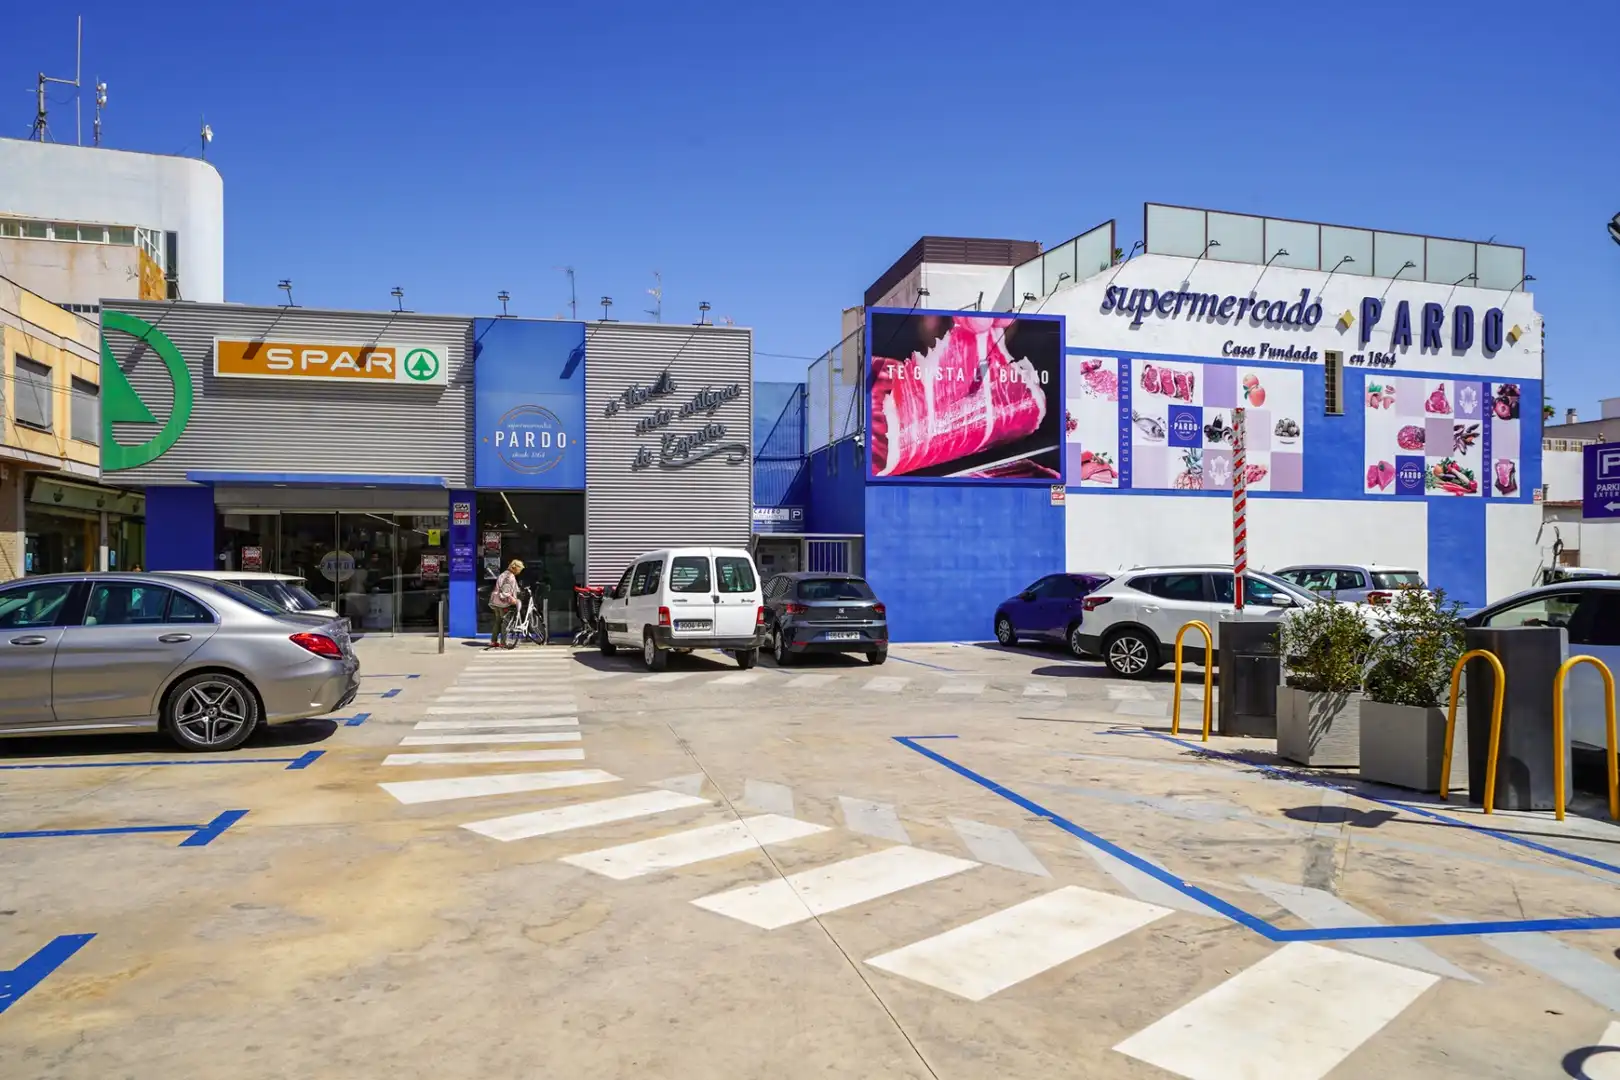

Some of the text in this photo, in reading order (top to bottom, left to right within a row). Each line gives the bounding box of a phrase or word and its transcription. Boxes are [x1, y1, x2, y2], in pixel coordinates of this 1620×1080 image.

[1101, 285, 1504, 354] supermercado PARDO
[266, 347, 392, 373] SPAR
[1223, 339, 1397, 367] Casa Fundada en 1864
[887, 364, 905, 380] TE
[1174, 422, 1198, 431] PARDO
[495, 431, 566, 448] PARDO
[1400, 471, 1422, 479] PARDO
